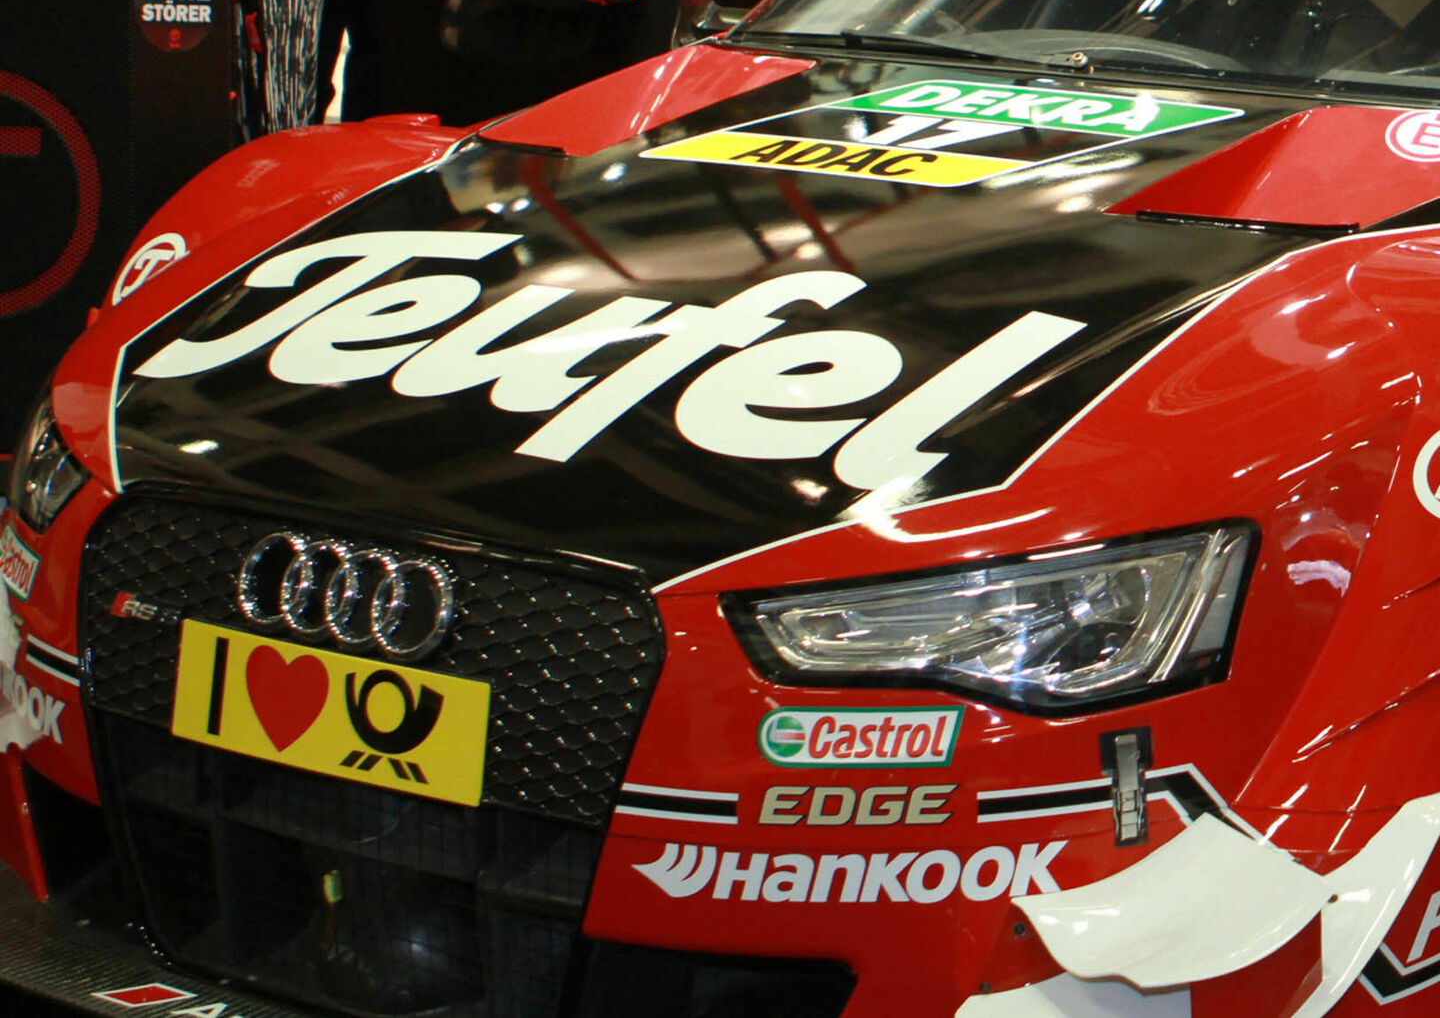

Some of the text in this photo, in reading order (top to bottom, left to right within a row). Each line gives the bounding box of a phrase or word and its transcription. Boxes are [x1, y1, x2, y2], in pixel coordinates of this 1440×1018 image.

[141, 0, 213, 23] STÖRER
[879, 84, 1162, 133] DEKRA
[858, 114, 1024, 150] 17
[730, 139, 938, 178] ADAC
[133, 230, 1089, 491] Teufel
[808, 715, 947, 759] Castrol
[758, 783, 959, 825] EDGE
